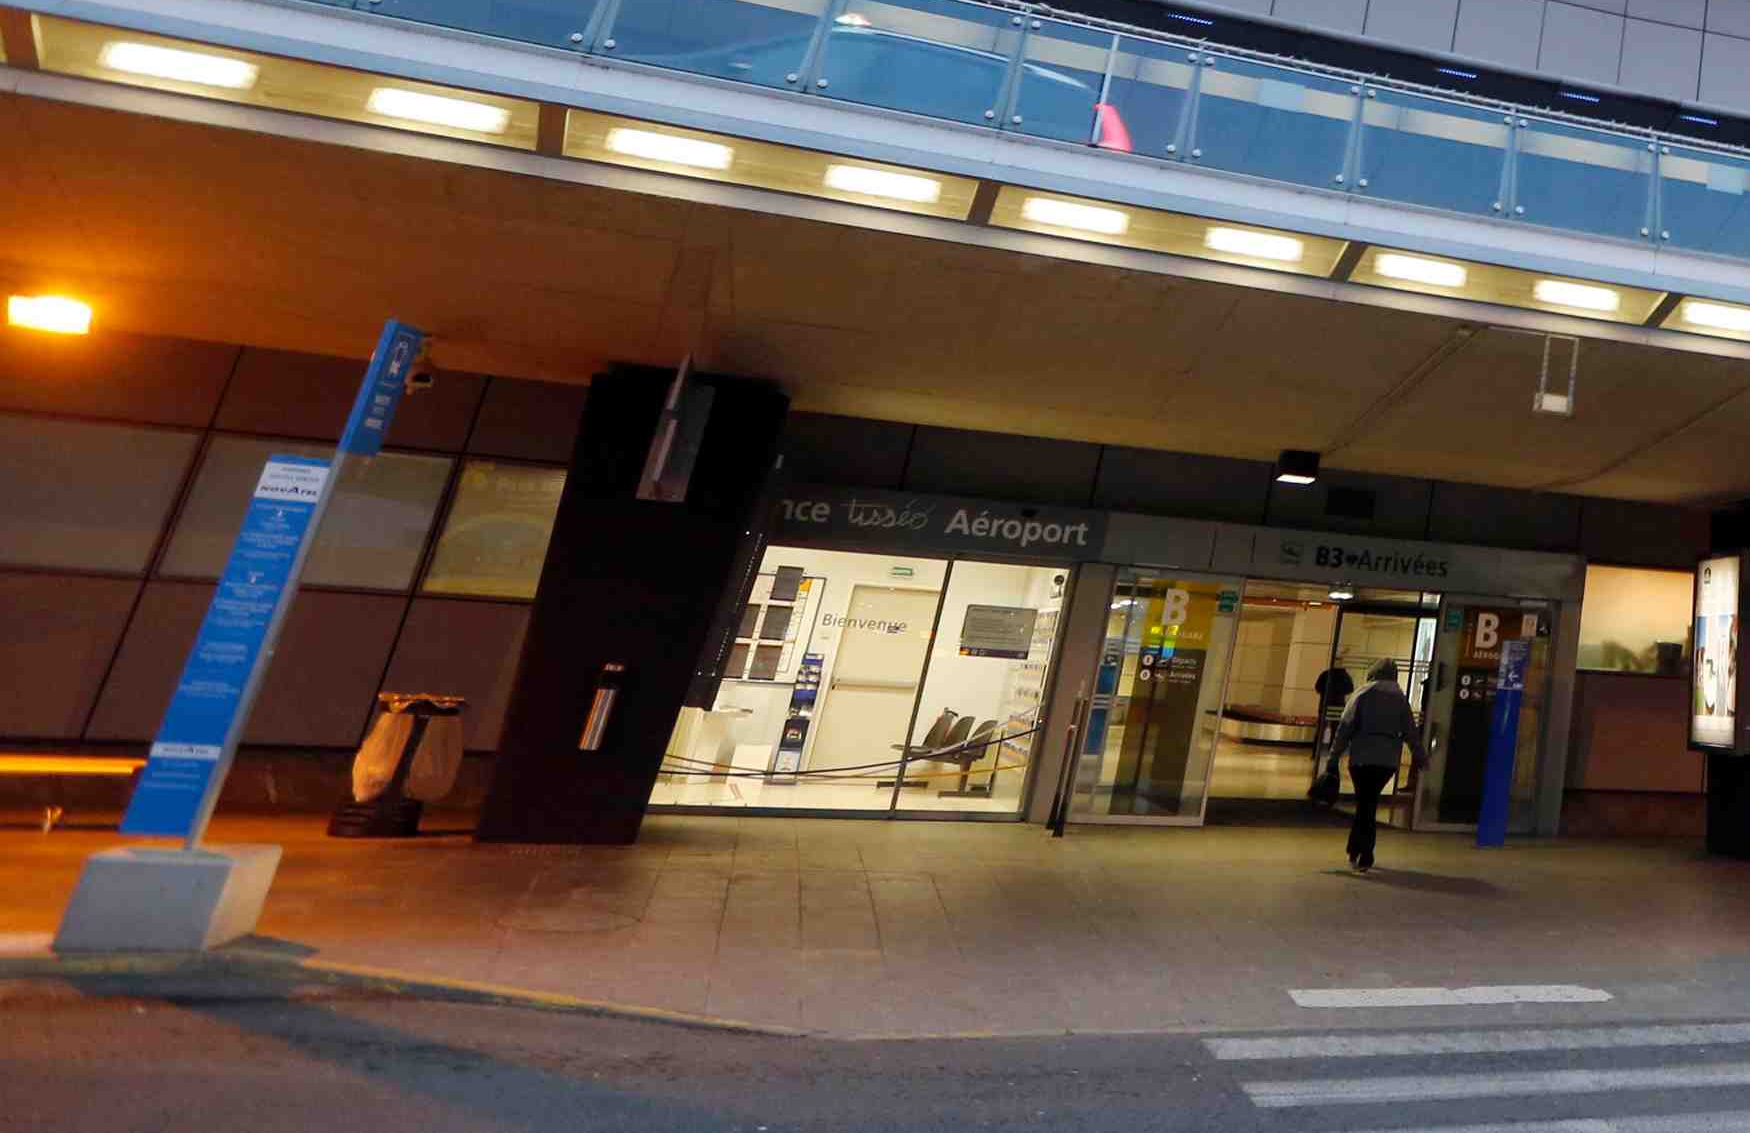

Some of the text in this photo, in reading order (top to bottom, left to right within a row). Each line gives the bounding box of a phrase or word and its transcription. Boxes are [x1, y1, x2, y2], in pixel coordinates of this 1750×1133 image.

[944, 509, 1089, 547] Aéroport
[1357, 549, 1449, 578] Arrivées
[822, 613, 908, 633] Bienvenue
[1161, 588, 1190, 627] B
[1475, 612, 1500, 649] B
